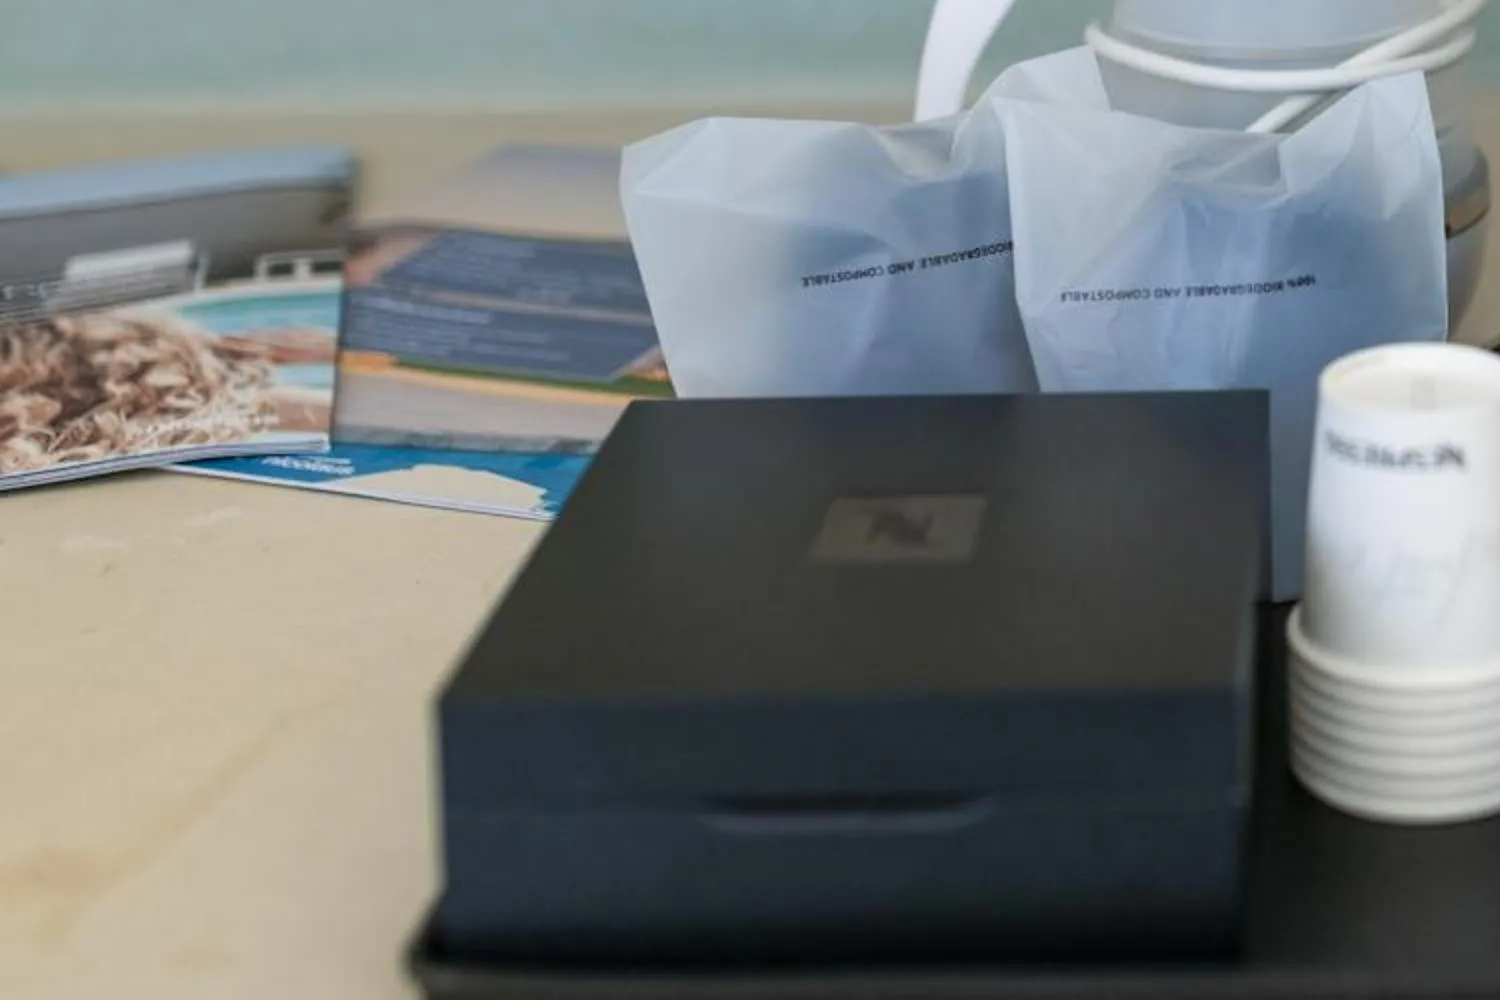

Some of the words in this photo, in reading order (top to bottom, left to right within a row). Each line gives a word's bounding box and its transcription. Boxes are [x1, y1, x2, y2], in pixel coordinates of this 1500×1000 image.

[887, 259, 915, 275] AND
[802, 264, 885, 288] COMPOSTABLE
[1060, 287, 1151, 303] COMPOSTABLE
[1153, 286, 1182, 299] AND
[1186, 281, 1285, 298] BIODEGRADABLE
